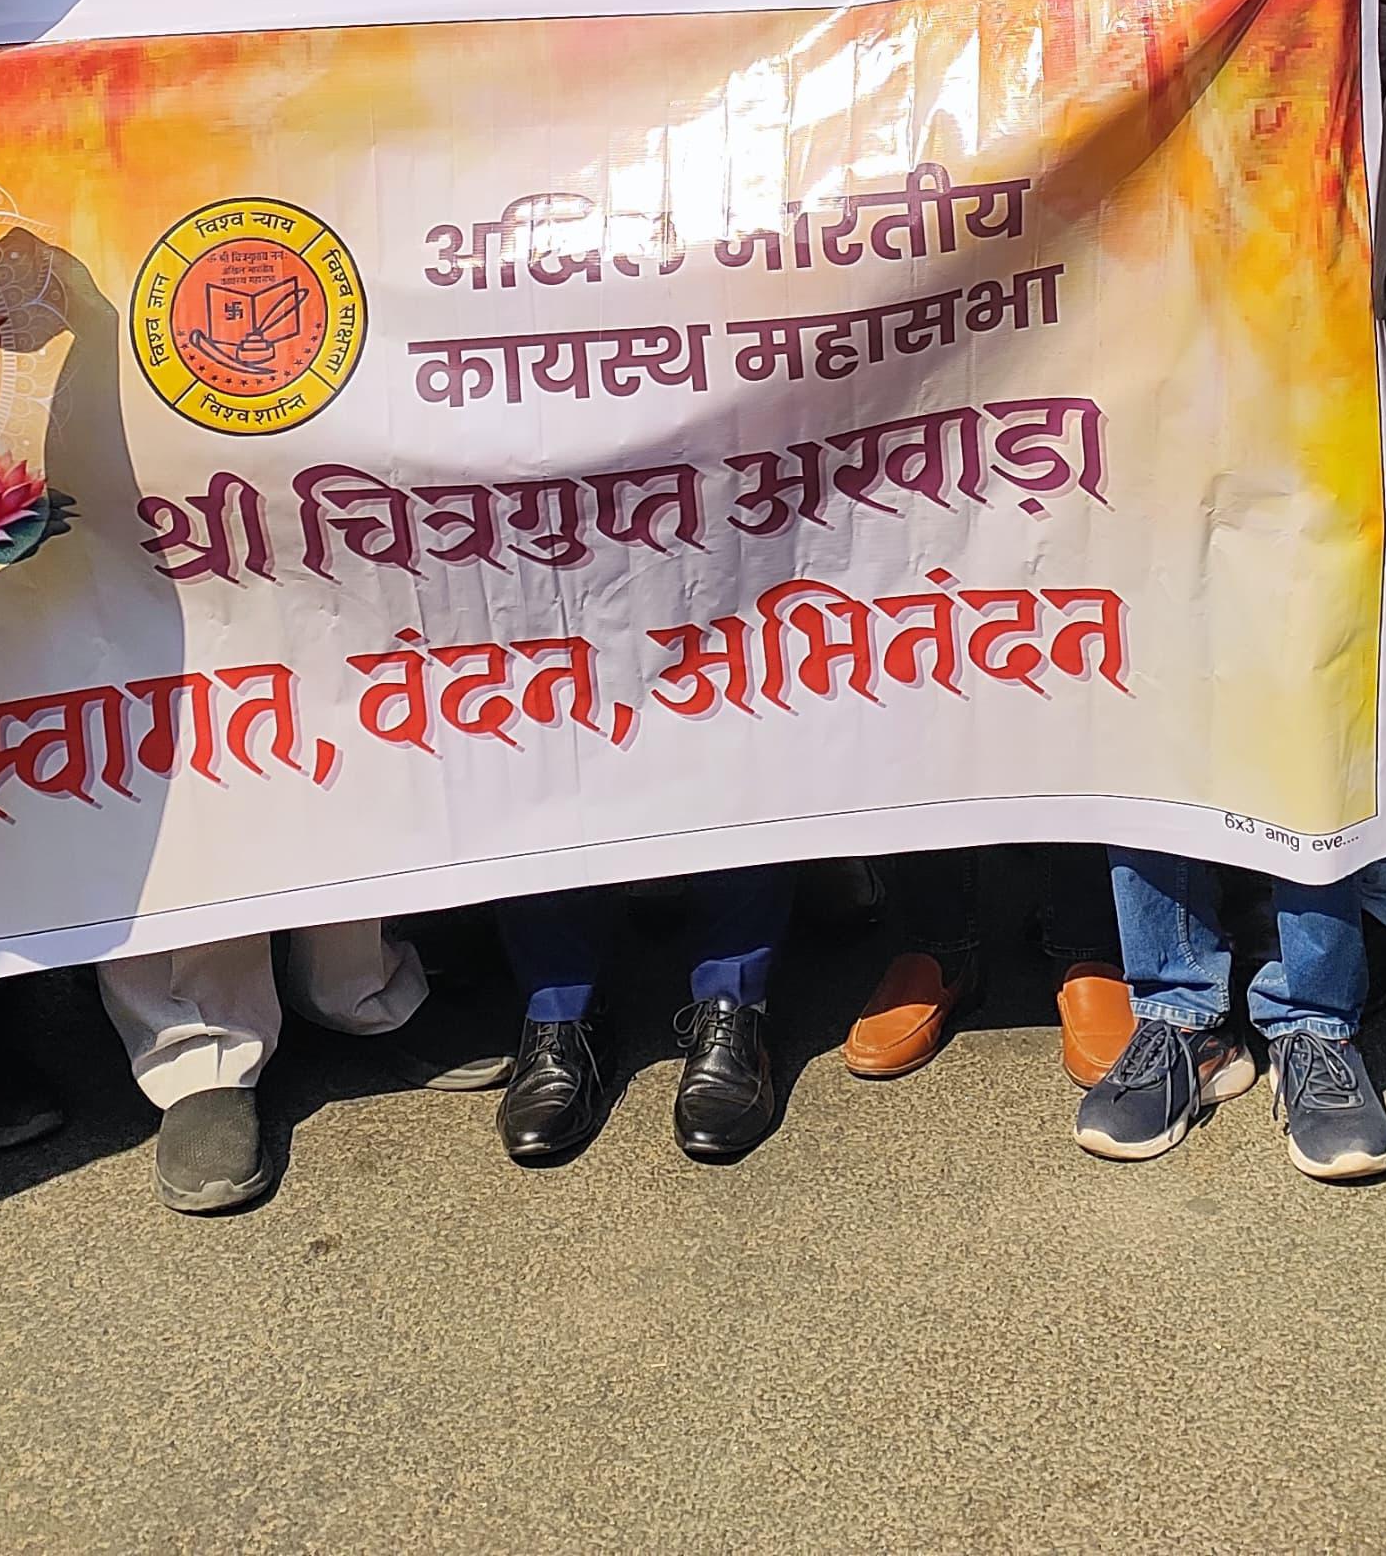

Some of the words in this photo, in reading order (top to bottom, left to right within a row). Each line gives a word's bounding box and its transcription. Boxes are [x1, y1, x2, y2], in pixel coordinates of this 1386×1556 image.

[195, 213, 245, 237] विश्व
[252, 213, 296, 234] न्याय
[148, 272, 170, 309] ज्ञान
[321, 249, 354, 298] विश्व
[146, 317, 169, 367] विश्व
[325, 303, 356, 375] साक्षरता
[407, 324, 711, 407] कायस्थ
[727, 264, 1064, 382] महासभा
[200, 394, 249, 423] विश्व
[253, 393, 307, 424] शान्ति
[136, 472, 283, 586] श्री
[293, 463, 712, 586] चित्रगुप्त
[723, 397, 1115, 537] अखाड़ा
[1225, 813, 1255, 834] 6x3
[1265, 827, 1300, 852] amg
